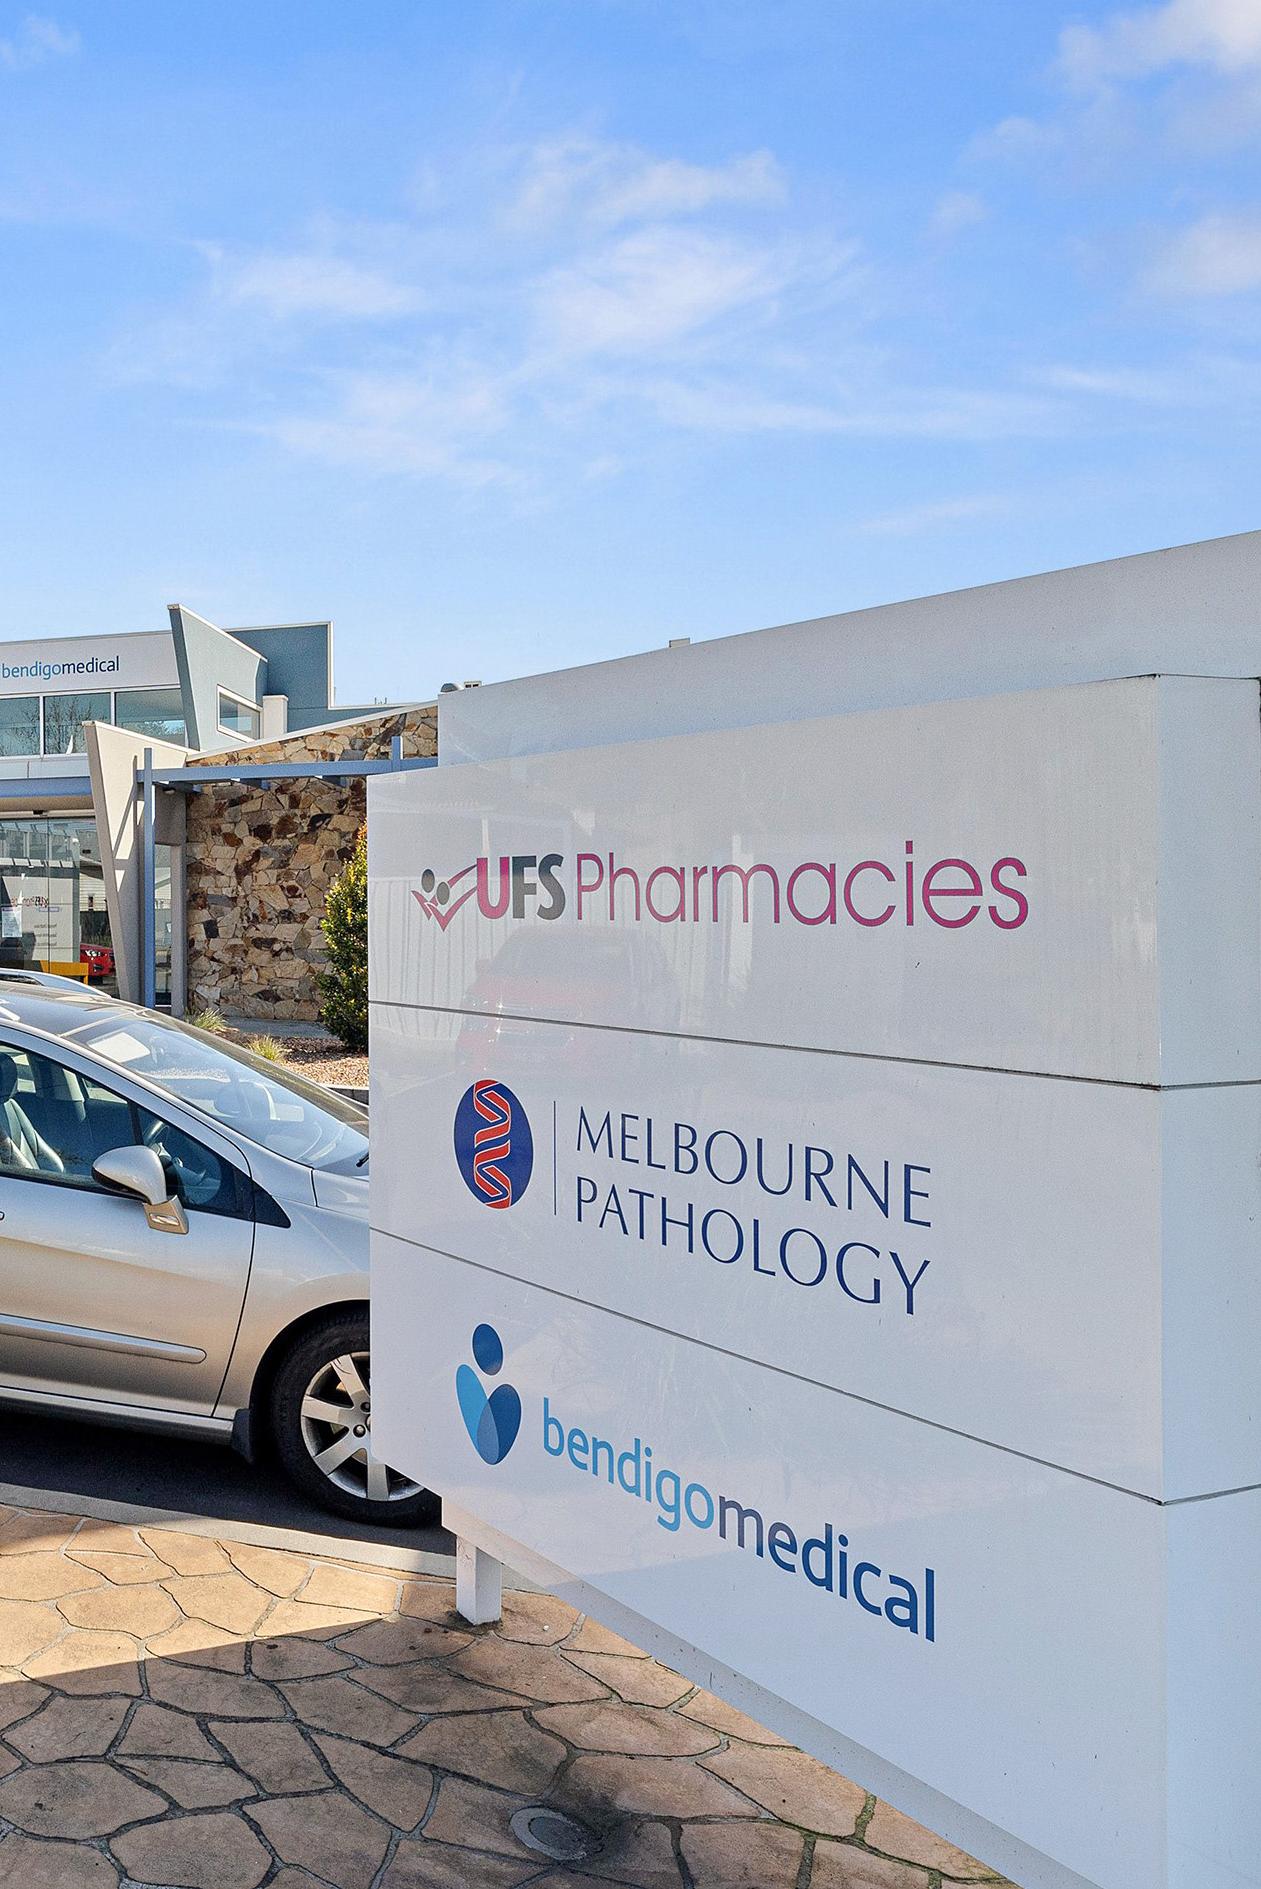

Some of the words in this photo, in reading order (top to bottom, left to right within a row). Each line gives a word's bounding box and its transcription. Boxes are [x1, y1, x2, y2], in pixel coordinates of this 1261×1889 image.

[1, 655, 120, 680] bendigomedical
[475, 852, 567, 921] UFS
[575, 839, 1031, 931] Pharmacies
[575, 1105, 933, 1229] MELBOURNE
[575, 1176, 932, 1317] PATHOLOGY
[542, 1396, 936, 1643] bendigomedical
